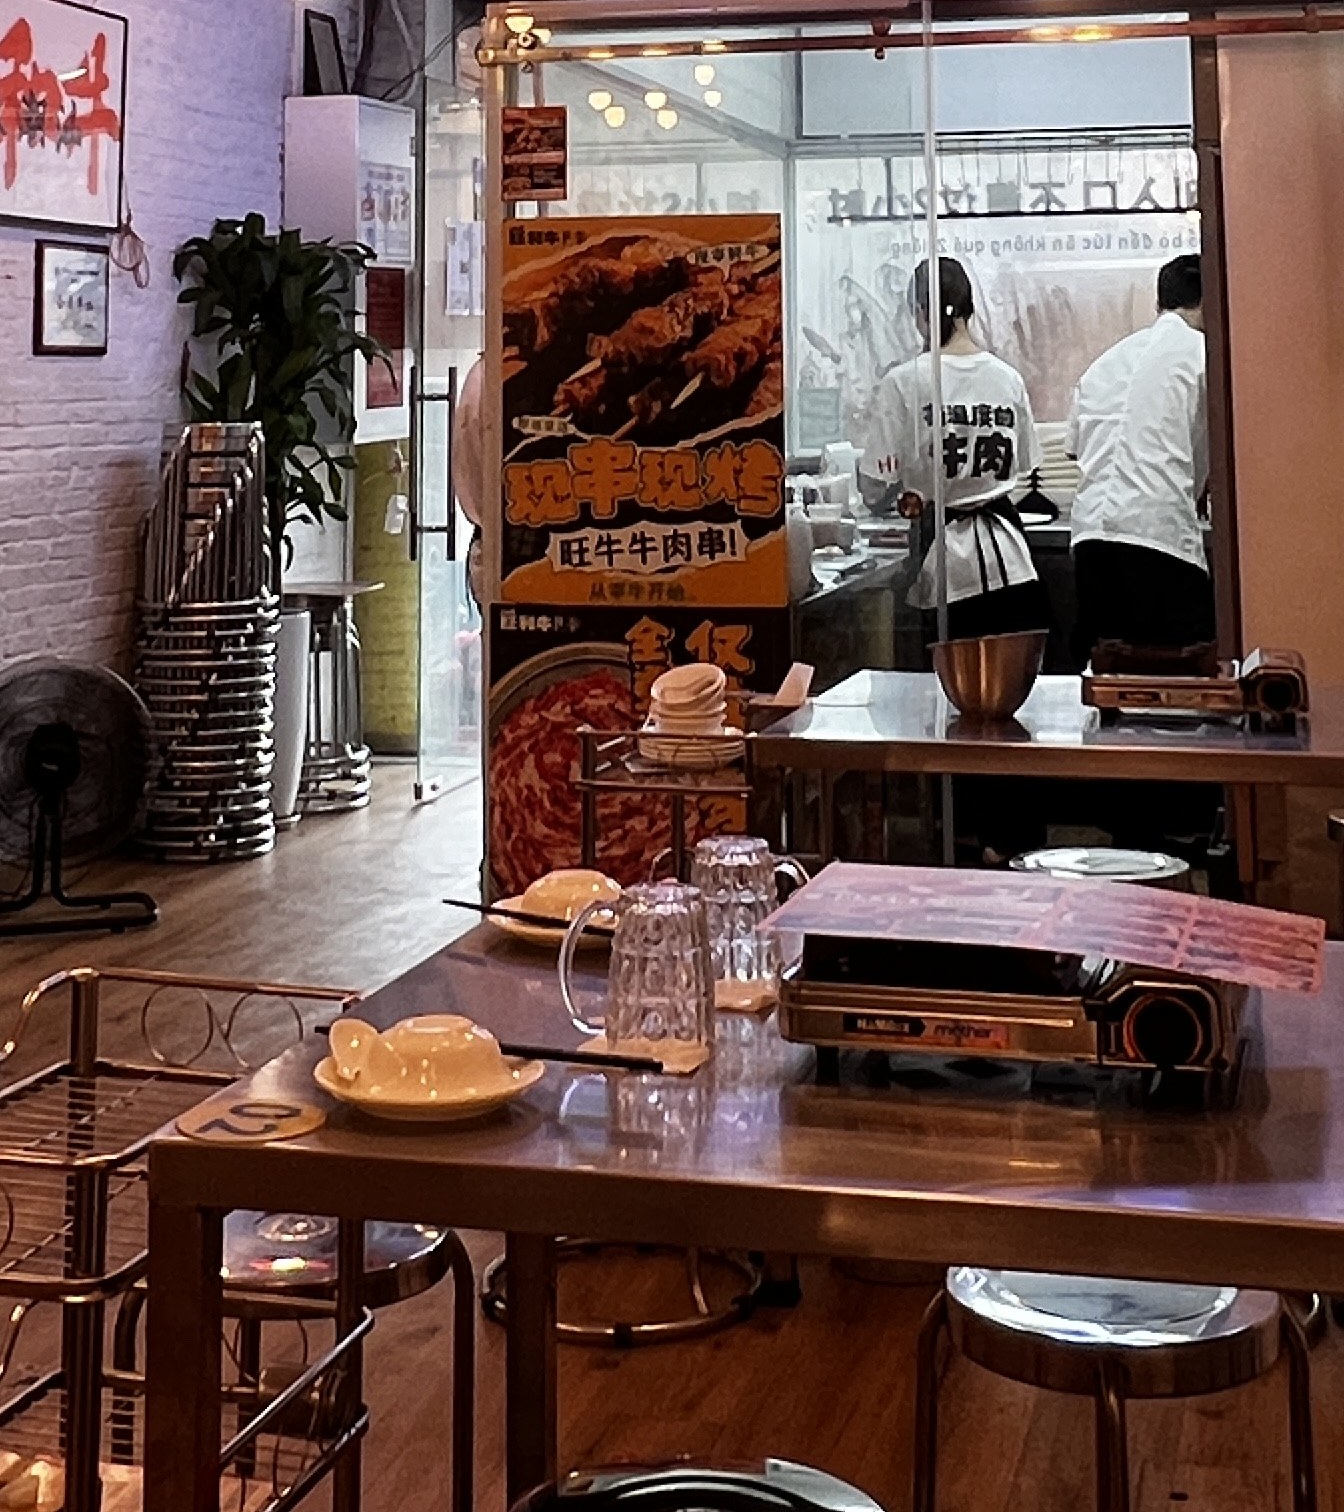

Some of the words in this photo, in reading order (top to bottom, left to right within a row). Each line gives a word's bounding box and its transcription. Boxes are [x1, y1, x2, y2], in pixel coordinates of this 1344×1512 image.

[560, 529, 738, 568] 旺牛牛肉串!
